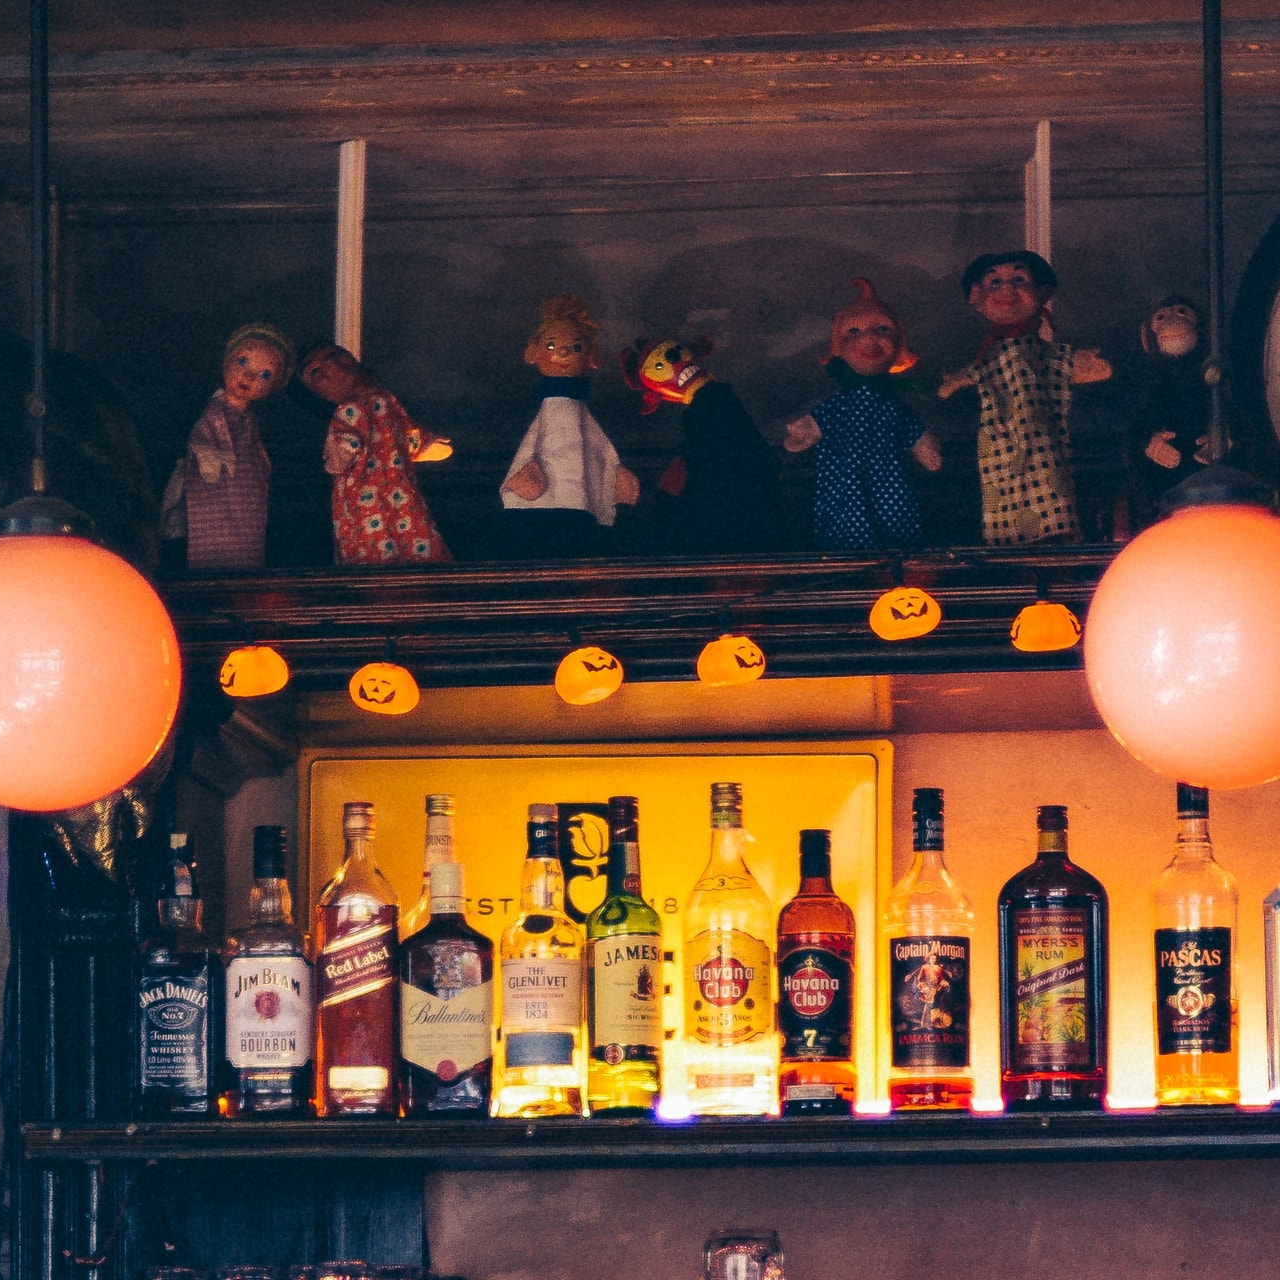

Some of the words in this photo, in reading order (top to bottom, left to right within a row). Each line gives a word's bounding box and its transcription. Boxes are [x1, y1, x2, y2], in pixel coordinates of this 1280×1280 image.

[466, 898, 515, 915] ST
[895, 942, 928, 960] Captain
[928, 940, 966, 960] Morgan
[1022, 937, 1079, 949] MYERS'S
[324, 957, 353, 979] Red
[354, 946, 390, 972] Label
[1035, 950, 1064, 961] RUM
[1161, 949, 1222, 968] PASCAS
[526, 967, 546, 976] THE
[693, 965, 754, 982] Havana
[1017, 974, 1057, 997] Original
[1058, 961, 1086, 981] Dark
[234, 972, 259, 998] JIM
[262, 968, 302, 996] BEAM
[508, 976, 568, 989] GLENLIVET
[705, 982, 742, 999] Club
[784, 975, 840, 992] Havana
[139, 987, 165, 1008] JACK
[166, 982, 208, 1009] DANIEL'S
[794, 991, 828, 1007] Club
[407, 1001, 487, 1026] Ballantine's
[525, 1009, 549, 1019] 1824
[150, 1030, 196, 1041] Tennessee
[240, 1030, 267, 1038] KENTUCKY
[803, 1029, 818, 1048] 7
[150, 1046, 195, 1054] WHISKEY
[239, 1038, 297, 1052] BOURBON
